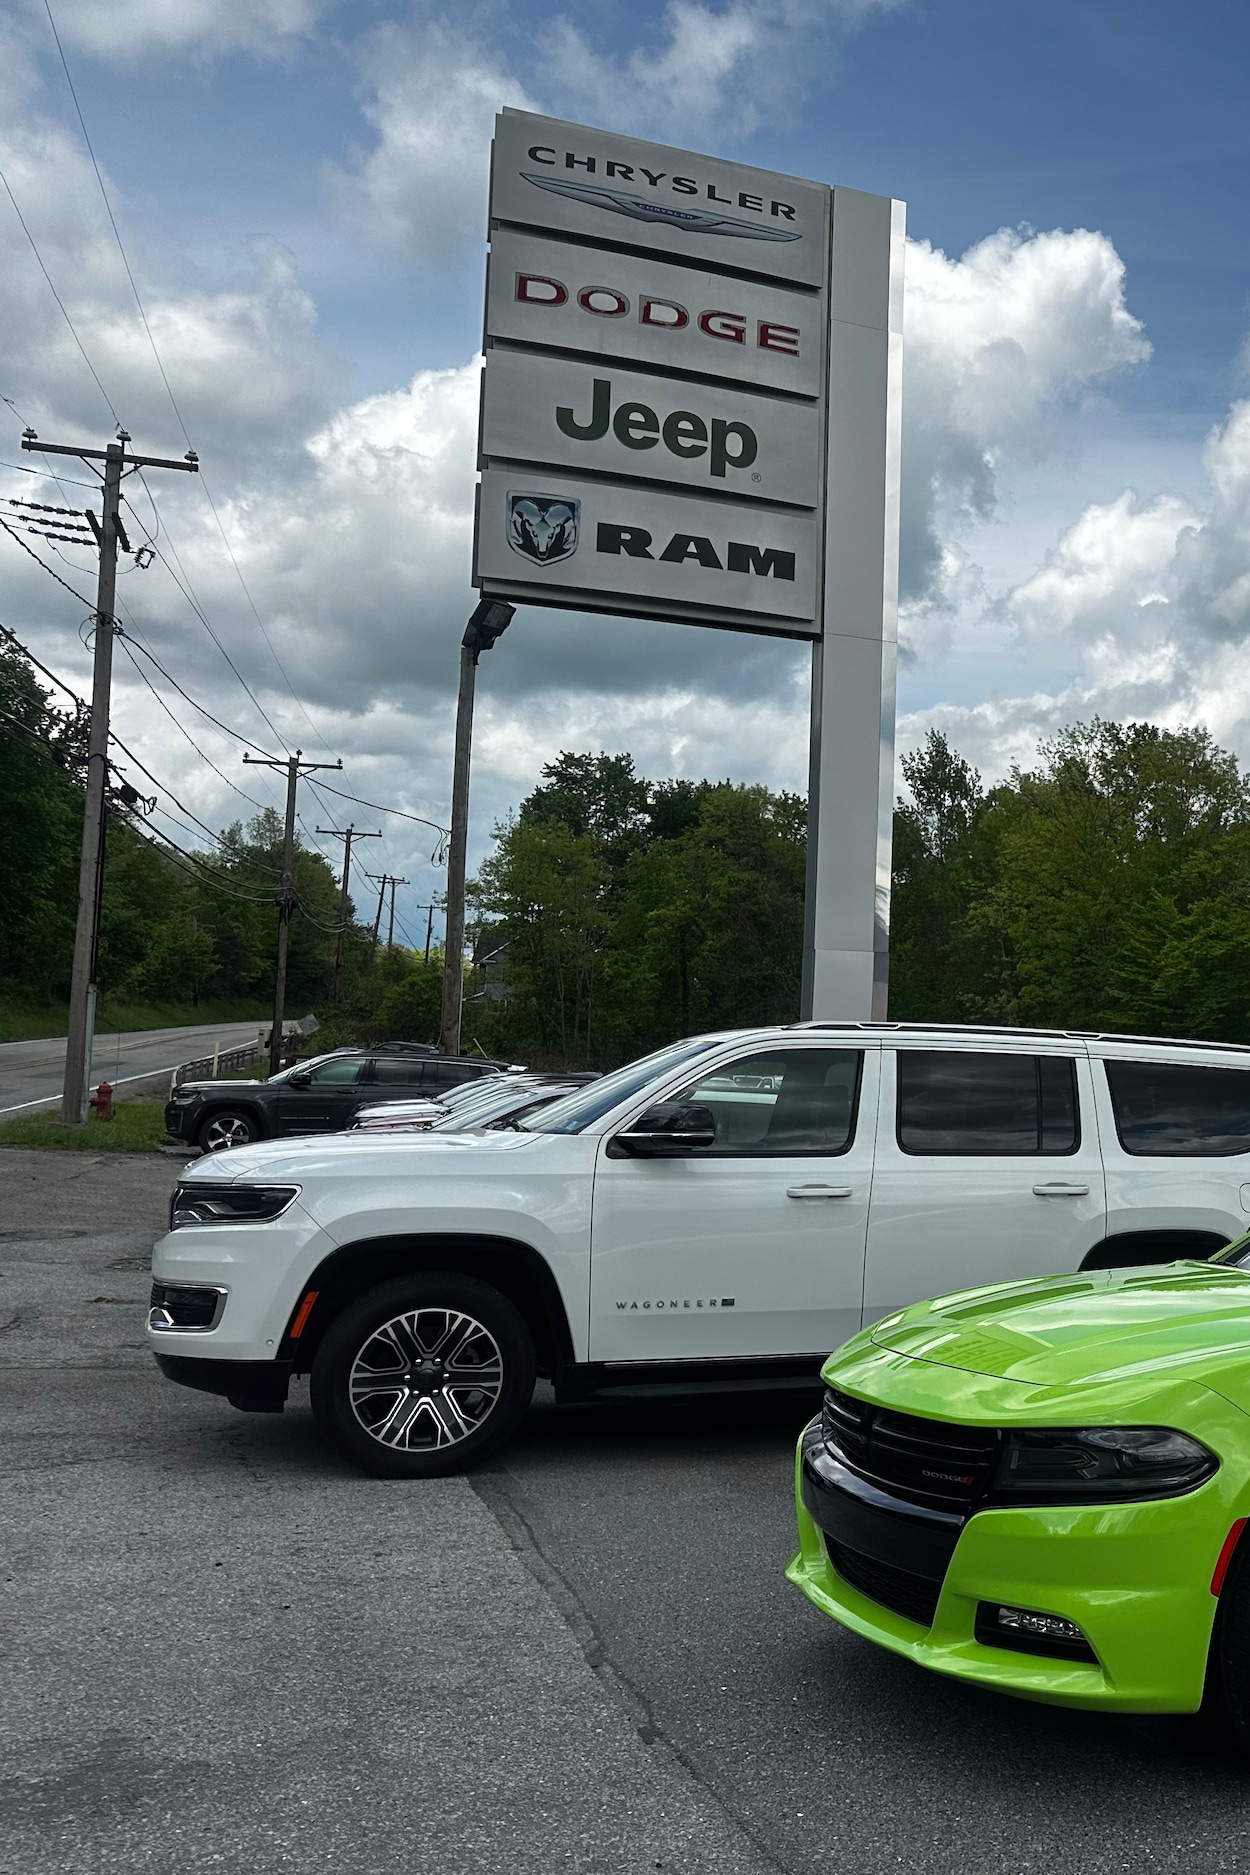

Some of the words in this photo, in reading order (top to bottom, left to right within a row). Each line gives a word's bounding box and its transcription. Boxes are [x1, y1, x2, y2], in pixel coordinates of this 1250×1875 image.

[527, 146, 798, 221] CHRYSLER
[638, 204, 694, 219] CHRYSLER
[514, 271, 801, 357] DODGE
[555, 379, 758, 477] Jeep
[596, 522, 796, 582] RAM
[616, 1298, 717, 1309] WAGONEER
[921, 1469, 968, 1484] DODGE
